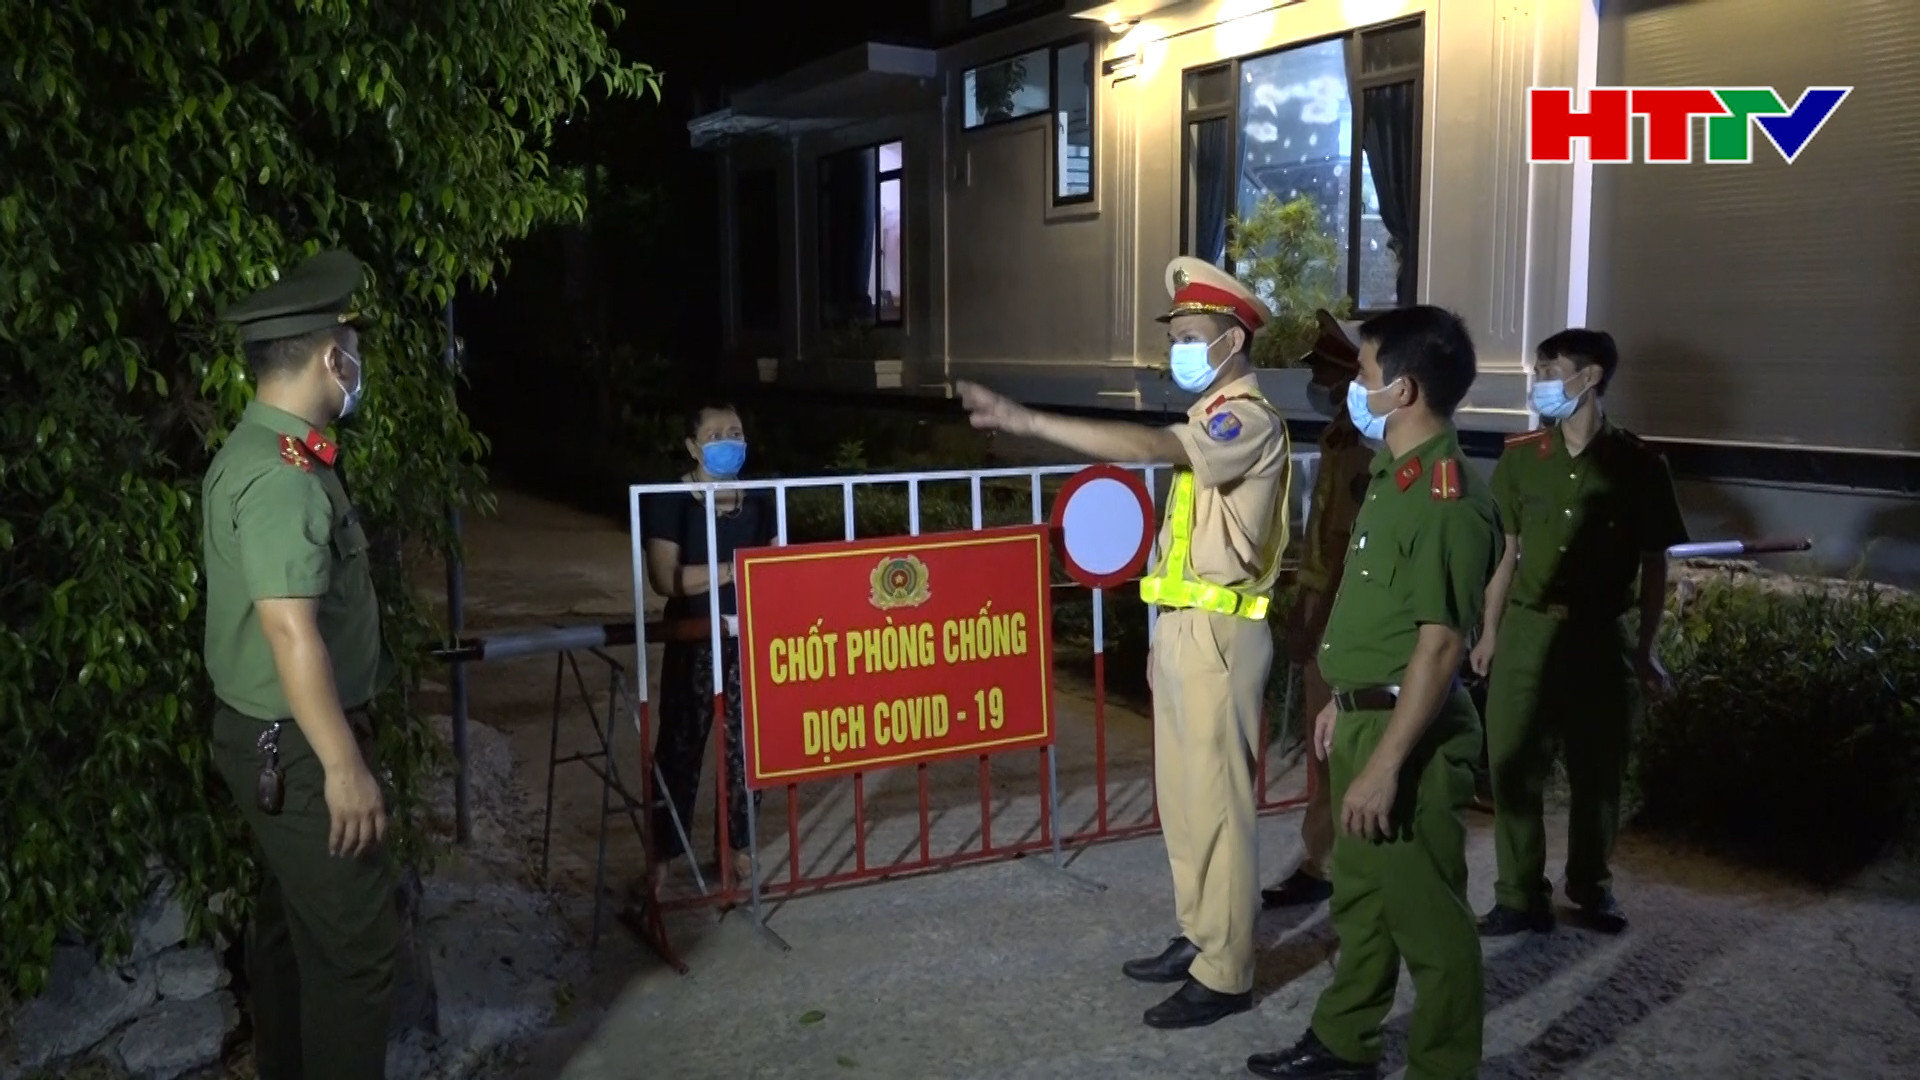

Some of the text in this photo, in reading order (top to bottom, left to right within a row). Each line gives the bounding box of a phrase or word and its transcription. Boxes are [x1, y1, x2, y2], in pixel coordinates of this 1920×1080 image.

[769, 600, 1028, 684] CHỐT PHÒNG CHỐNG
[803, 686, 1004, 763] DỊCH COVID - 19
